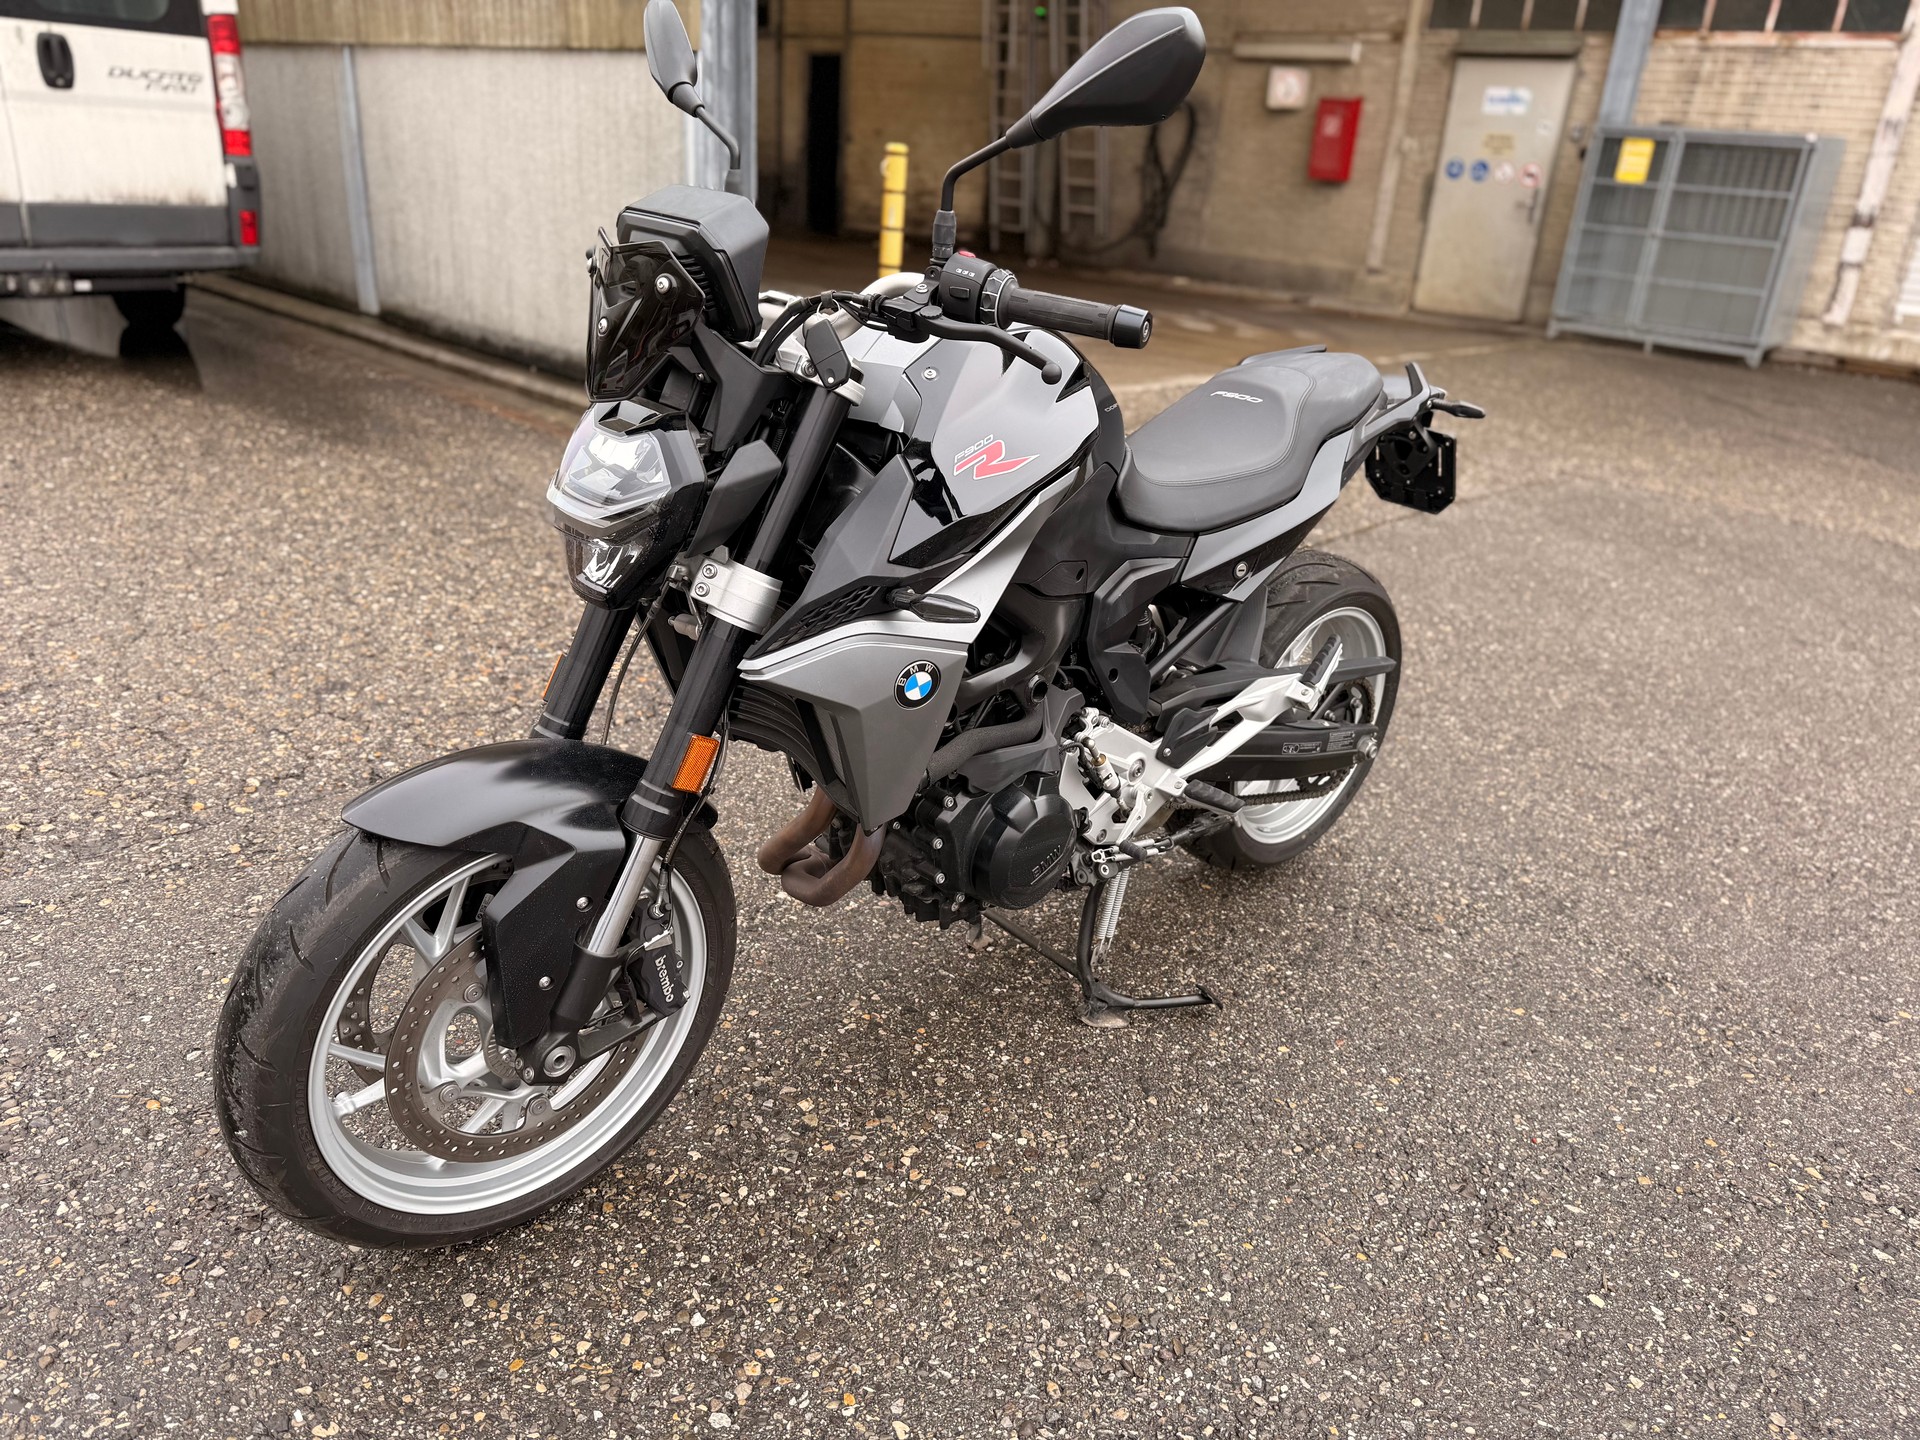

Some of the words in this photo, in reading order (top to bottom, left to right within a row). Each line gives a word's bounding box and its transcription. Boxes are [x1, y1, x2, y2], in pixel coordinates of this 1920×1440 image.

[1210, 391, 1264, 404] F900
[953, 439, 1041, 480] R
[954, 433, 994, 464] F900
[897, 663, 934, 687] BMW
[1032, 844, 1061, 879] BMW
[654, 954, 674, 1003] brembo
